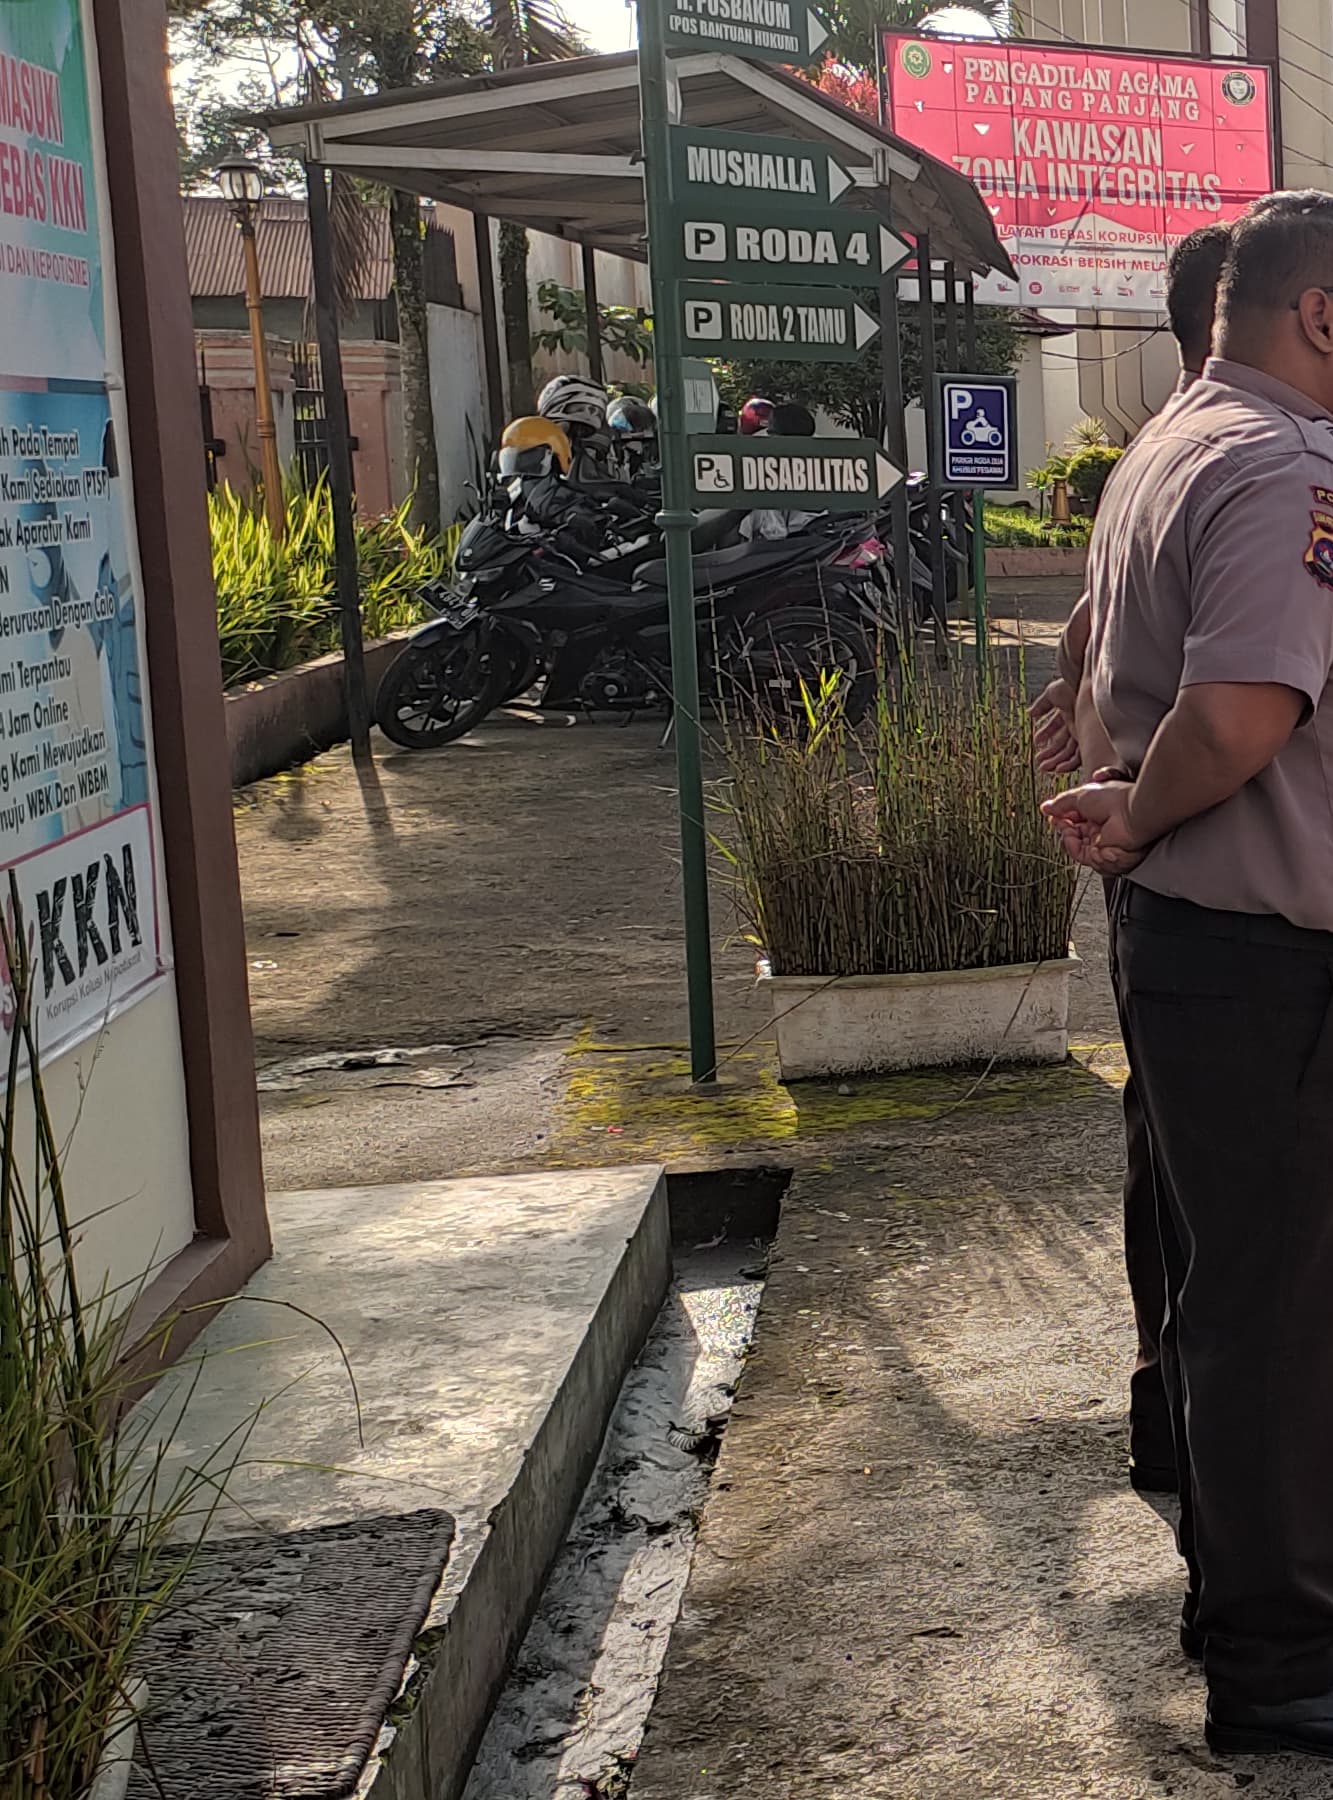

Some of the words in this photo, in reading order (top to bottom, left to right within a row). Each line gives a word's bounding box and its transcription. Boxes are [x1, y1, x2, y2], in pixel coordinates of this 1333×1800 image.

[669, 14, 698, 35] (POS
[700, 19, 753, 45] BANTUAN
[754, 29, 799, 52] HUKUM)
[964, 57, 1111, 93] PENGADILAN
[1119, 71, 1199, 99] AGAMA
[965, 82, 1074, 111] PADANG
[1083, 92, 1201, 121] PANJANG
[1012, 118, 1164, 167] KAWASAN
[687, 146, 816, 194] MUSHALLA
[952, 155, 1040, 201] ZONA
[1048, 161, 1222, 212] INTEGRITAS
[50, 154, 87, 232] KKN
[736, 226, 838, 266] RODA
[844, 234, 870, 266] 4
[1050, 229, 1093, 241] BEBAS
[1098, 231, 1158, 245] KORUPSI
[7, 244, 31, 276] DAN
[1078, 258, 1126, 270] BERSIH
[730, 304, 782, 342] RODA
[784, 307, 796, 339] 2
[799, 307, 847, 345] TAMU
[951, 389, 973, 420] P
[12, 428, 41, 457] Pada
[42, 431, 79, 463] Tempat
[1, 470, 30, 497] Kami
[33, 470, 81, 497] Sediakan
[82, 468, 110, 500] (PTSP)
[743, 456, 869, 493] DISABILITAS
[16, 518, 62, 552] Aparatur
[65, 512, 91, 542] Kami
[54, 595, 92, 629] Dengan
[94, 585, 114, 617] Calo
[18, 655, 71, 692] Terpantau
[8, 707, 31, 739] Jam
[34, 696, 68, 727] Online
[11, 742, 40, 781] Kami
[42, 725, 105, 769] Mewujudkan
[26, 786, 52, 822] WBK
[55, 779, 76, 810] Dan
[77, 762, 109, 801] WBBM
[35, 842, 143, 1001] KKN
[45, 992, 79, 1019] Korupsi
[79, 976, 103, 999] Kolusi
